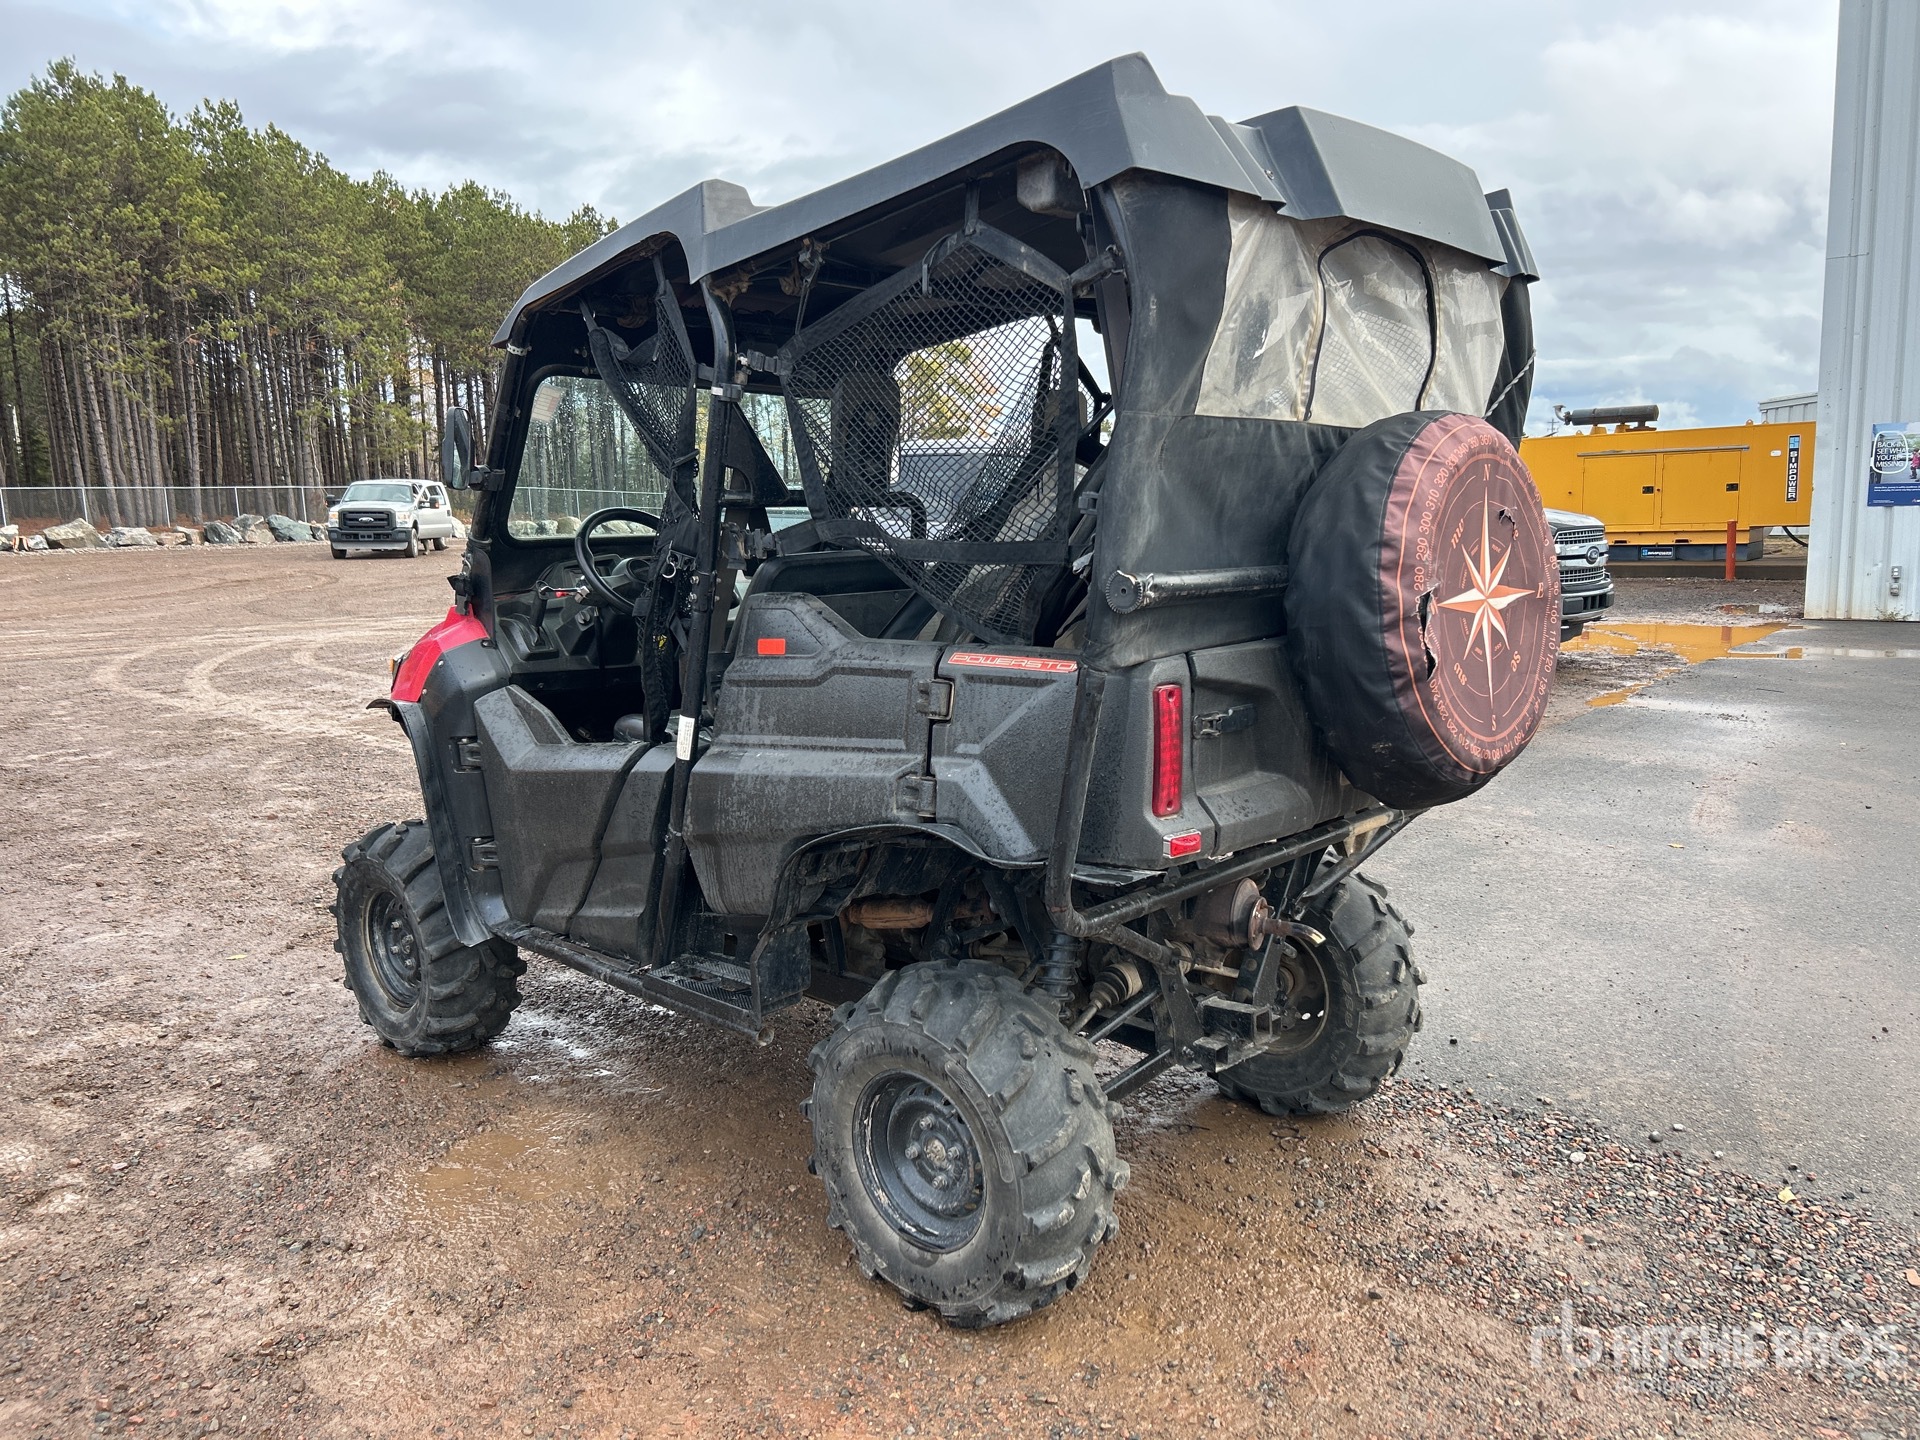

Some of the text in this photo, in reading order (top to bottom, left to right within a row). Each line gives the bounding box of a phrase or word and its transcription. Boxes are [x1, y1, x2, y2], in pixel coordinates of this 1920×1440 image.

[1454, 442, 1469, 458] 340
[1467, 435, 1480, 449] 350
[1480, 434, 1493, 446] 360
[1445, 453, 1459, 470] 330
[1433, 467, 1449, 488] 320
[1483, 464, 1491, 481] N
[1788, 451, 1798, 499] SIMPOWER
[1425, 489, 1440, 511] 310
[1418, 511, 1433, 535] 300
[1415, 537, 1428, 562] 290
[1549, 555, 1558, 570] 80
[1413, 566, 1425, 592] 280
[1536, 582, 1544, 599] E
[1548, 630, 1556, 650] 110
[1544, 653, 1554, 673] 120
[1429, 678, 1441, 702] 240
[1538, 676, 1548, 696] 130
[1491, 714, 1497, 731] S
